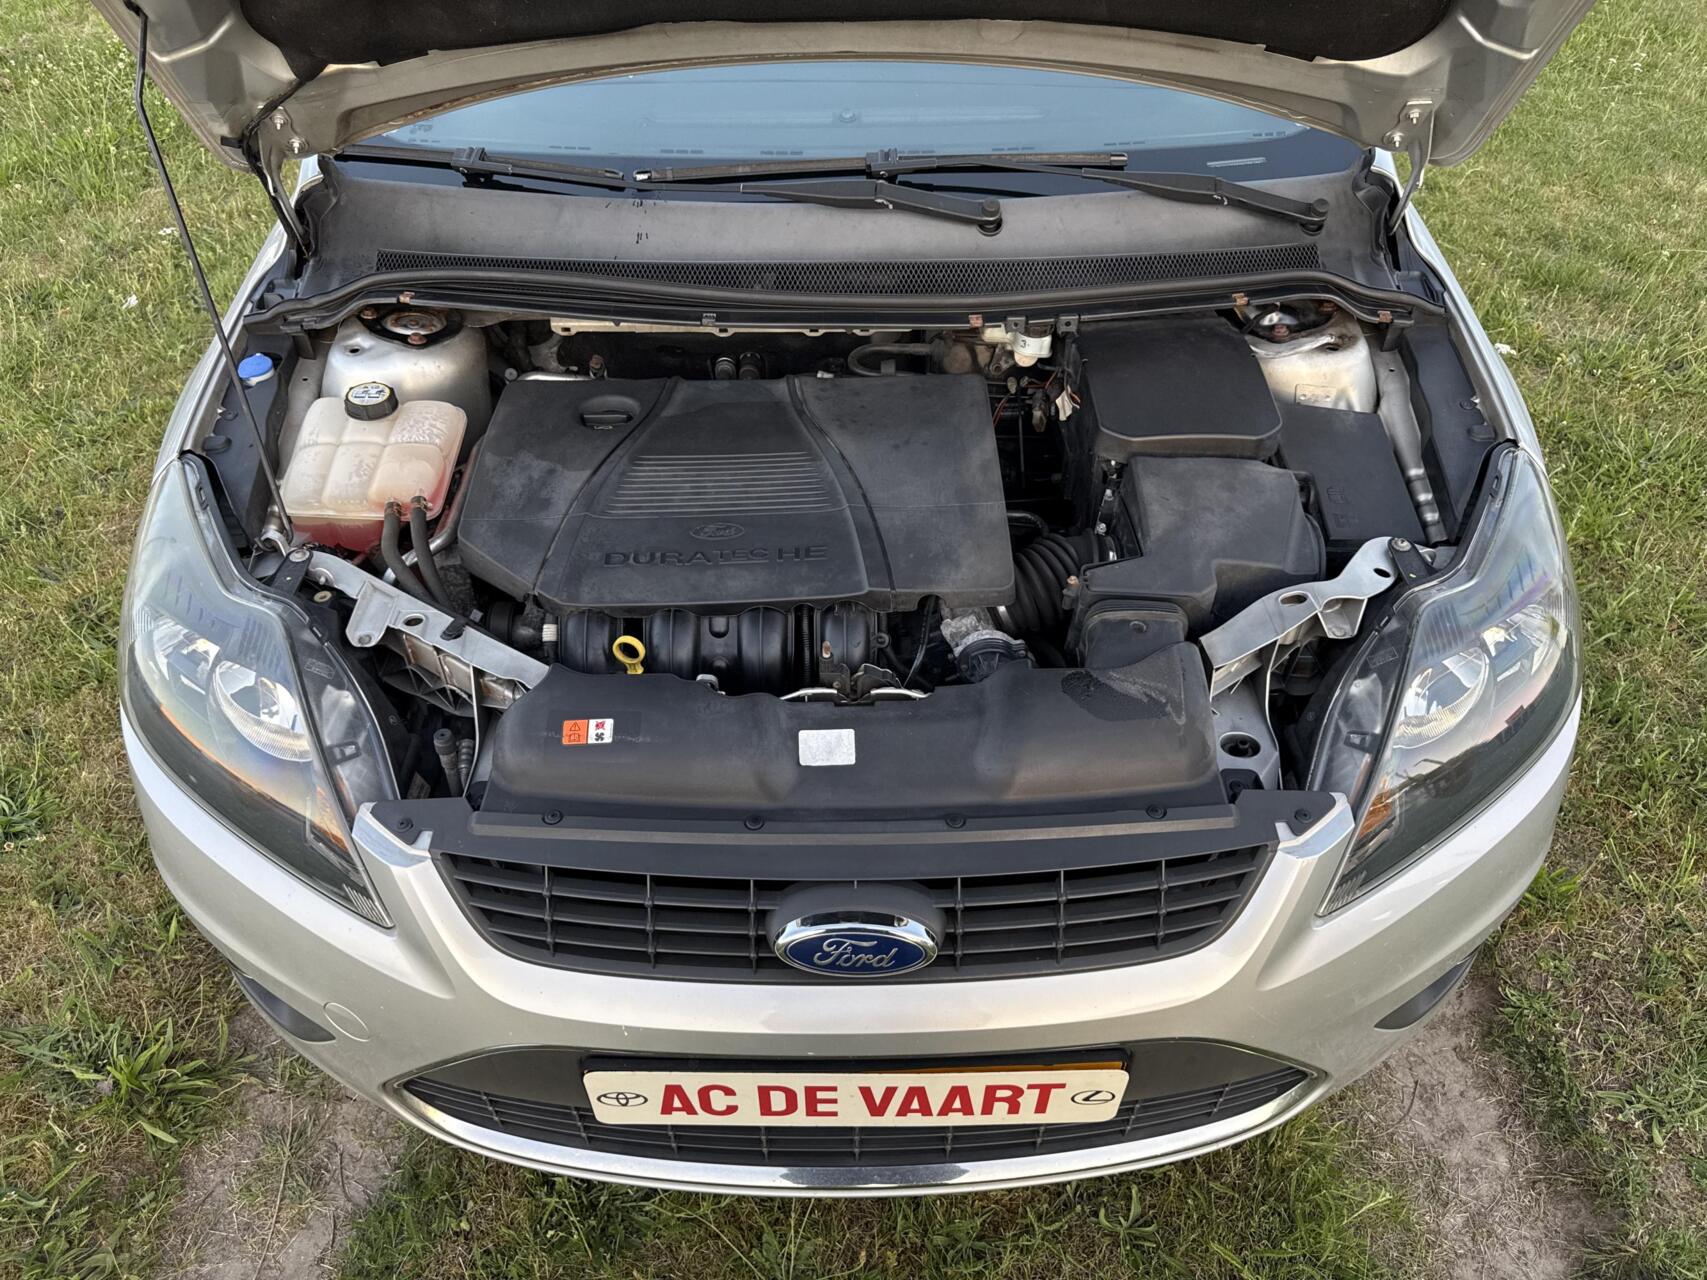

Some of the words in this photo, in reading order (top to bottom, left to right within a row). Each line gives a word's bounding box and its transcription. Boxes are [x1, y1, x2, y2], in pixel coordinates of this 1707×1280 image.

[604, 547, 769, 567] DURATEC
[776, 545, 830, 562] HE
[813, 937, 899, 968] Ford
[660, 1084, 739, 1116] AC
[757, 1085, 838, 1117] DE
[858, 1083, 1067, 1117] VAART
